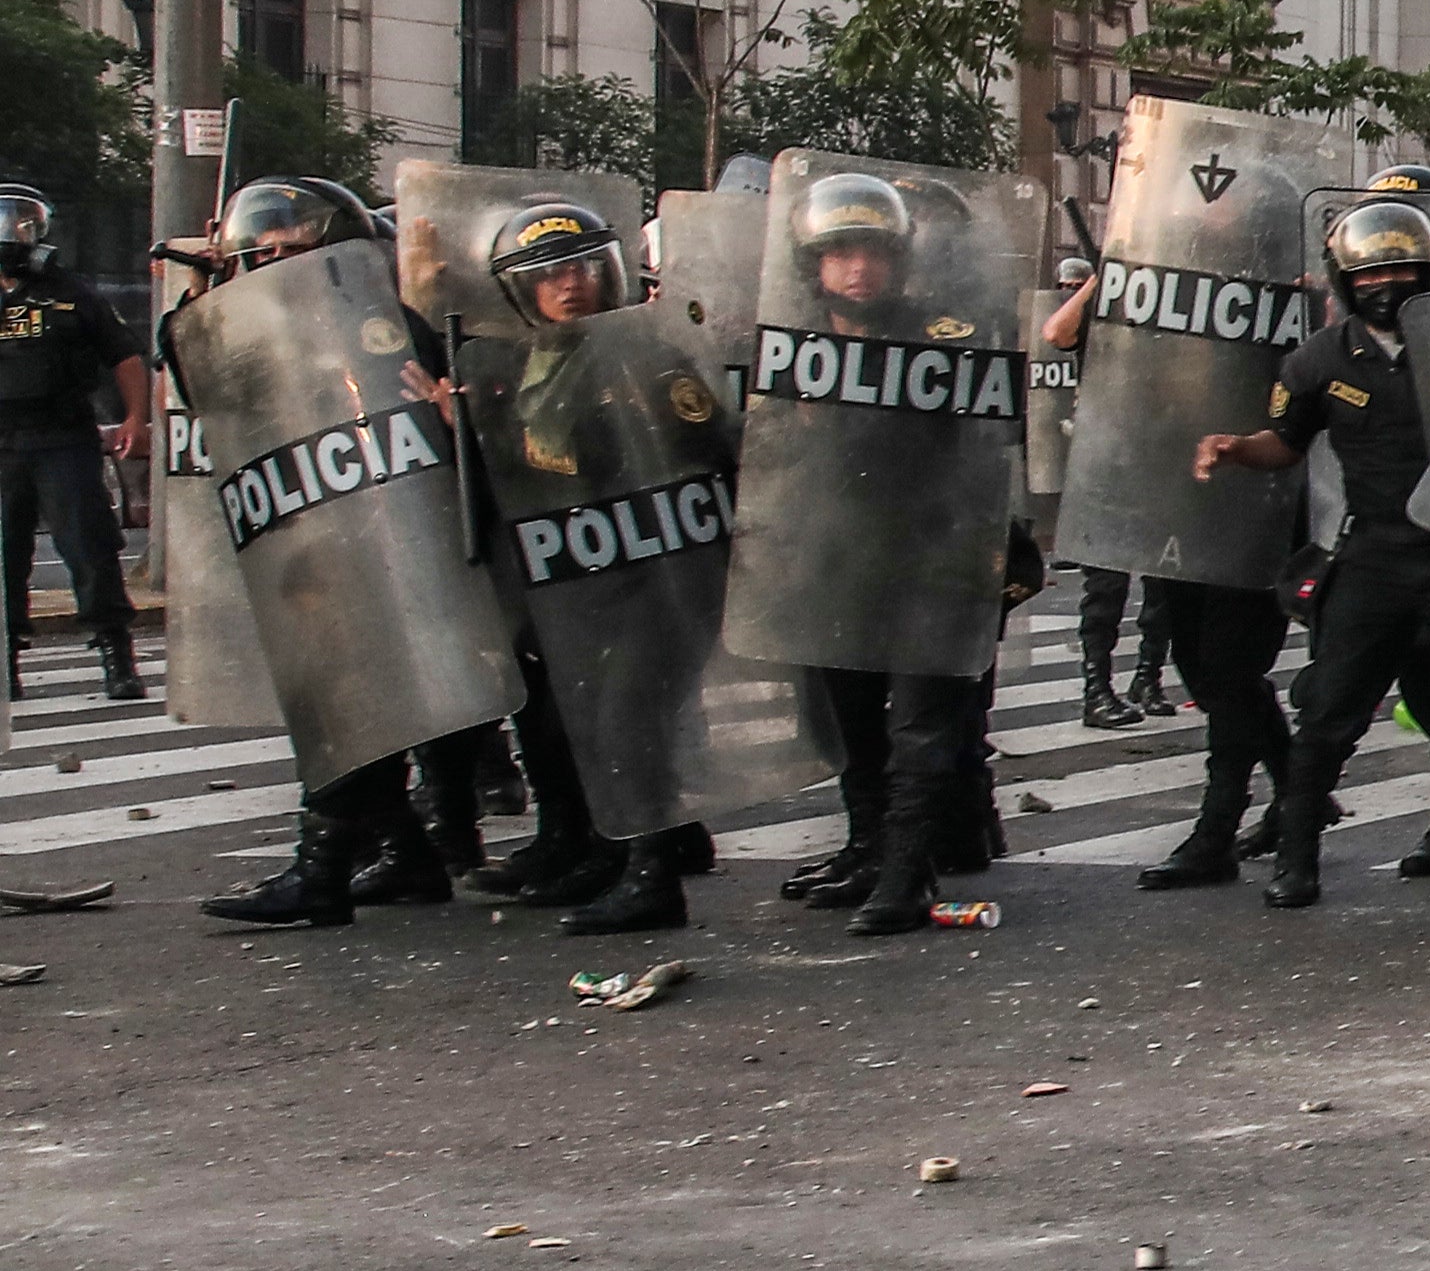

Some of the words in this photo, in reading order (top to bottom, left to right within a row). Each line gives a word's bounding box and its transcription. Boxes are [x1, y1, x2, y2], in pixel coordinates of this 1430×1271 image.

[1097, 261, 1308, 345] POLICIA
[756, 330, 1014, 417] POLICIA
[1029, 361, 1077, 388] POL
[223, 411, 439, 544] POLICIA
